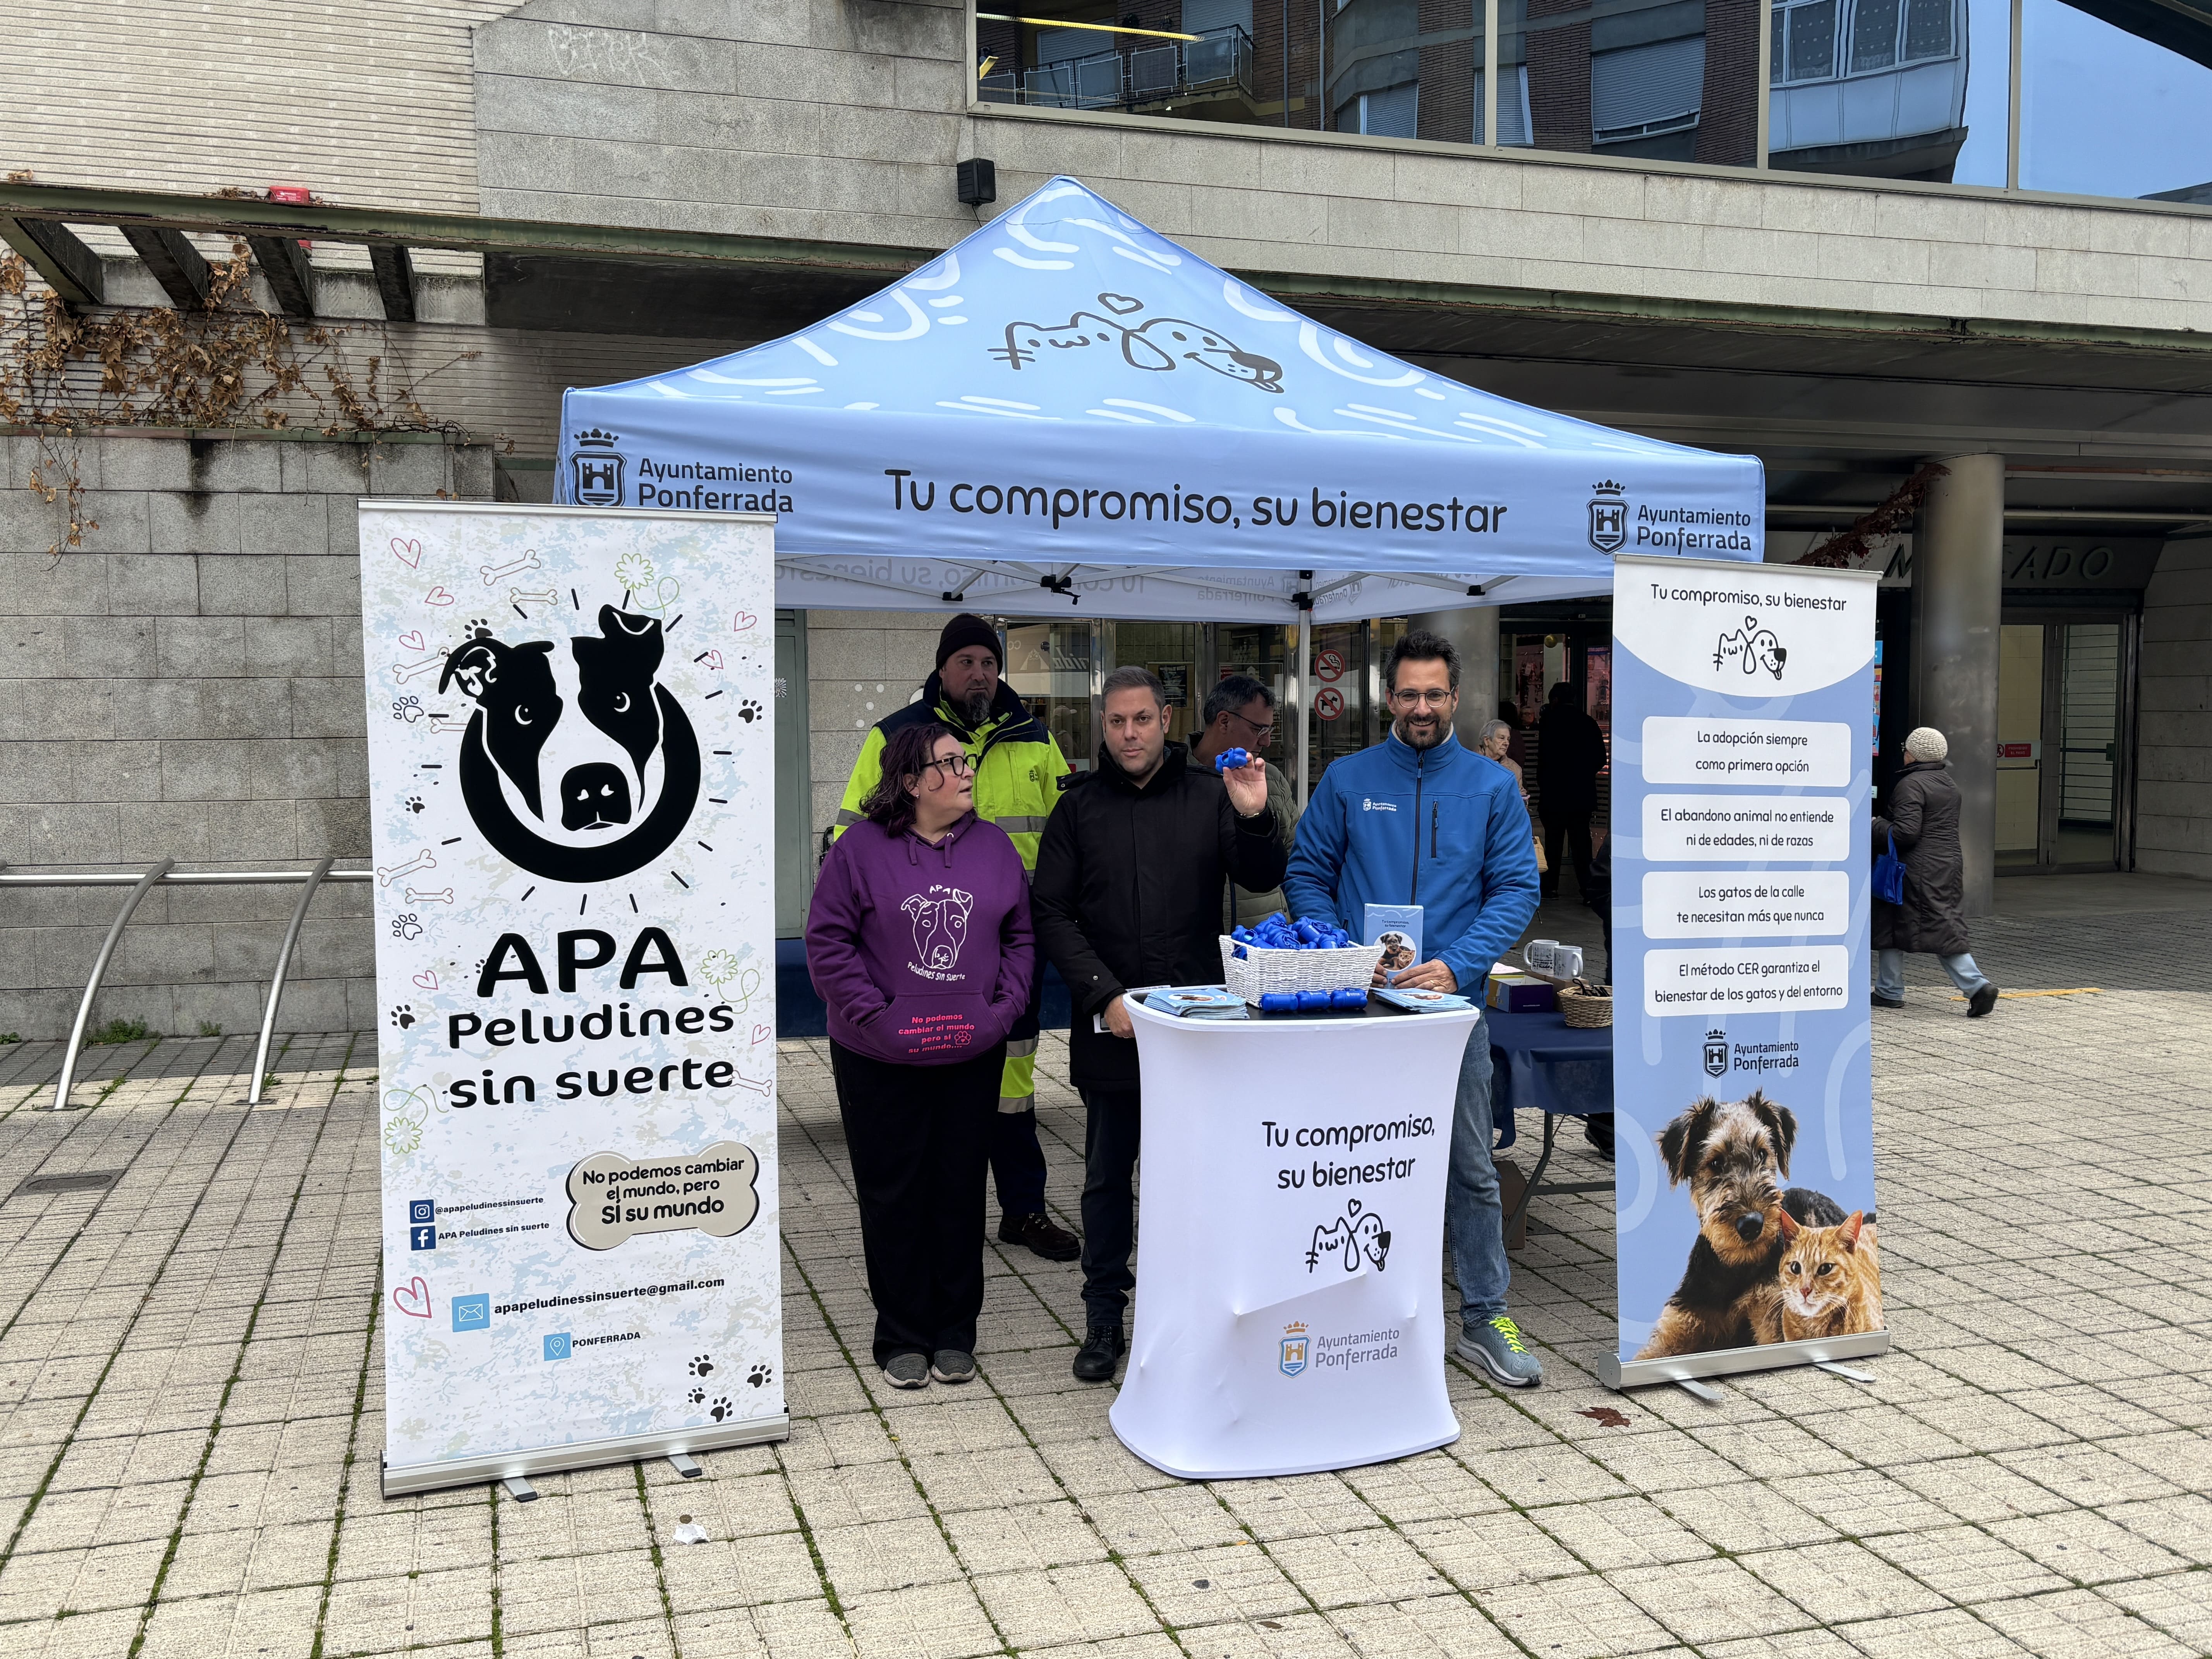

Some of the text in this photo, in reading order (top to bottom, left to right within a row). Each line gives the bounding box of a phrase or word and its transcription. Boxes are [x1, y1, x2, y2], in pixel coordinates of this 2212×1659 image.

[639, 458, 792, 484] Ayuntamiento
[639, 483, 793, 512] Ponferrada
[884, 469, 1507, 533] Tu compromiso, su bienestar
[1638, 505, 1750, 526] Ayuntamiento
[1637, 526, 1751, 555] Ponferrada
[1651, 584, 1846, 611] Tu compromiso, su bienestar
[1698, 731, 1807, 749] La adopción siempre
[1696, 759, 1809, 775] como primera opción
[1661, 808, 1834, 823] El abandono animal no entiende
[1687, 833, 1813, 847] ni de edades, ni de razas
[1699, 885, 1804, 901] Los gatos de la calle
[1677, 909, 1824, 925] te necesitan más que nunca
[475, 927, 689, 998] APA
[907, 961, 965, 981] Peludines sin suerte
[1680, 960, 1819, 977] El método CER garantiza el
[1655, 986, 1843, 1003] bienestar de los gatos y del entorno
[449, 1001, 733, 1049] Peludines
[926, 1014, 963, 1024] podemos
[921, 1036, 941, 1044] pero
[1734, 1041, 1799, 1057] Ayuntamiento
[1734, 1054, 1799, 1075] Ponferrada
[450, 1058, 734, 1108] sin suerte
[1262, 1113, 1434, 1152] Tu compromiso,
[583, 1158, 745, 1185] No podemos cambiar
[1278, 1157, 1415, 1189] su bienestar
[607, 1180, 720, 1200] el mundo, pero
[435, 1197, 543, 1214] @apapeludinessinsuerte
[602, 1195, 724, 1224] SÍ su mundo
[438, 1231, 457, 1240] APA
[459, 1228, 503, 1238] Peludines
[521, 1223, 549, 1231] suerte
[495, 1279, 724, 1315] apapeludinessinsuerte@gmail.com
[572, 1332, 641, 1348] PONFERRADA
[1317, 1328, 1400, 1351] Ayuntamiento
[1316, 1343, 1398, 1370] Ponferrada
